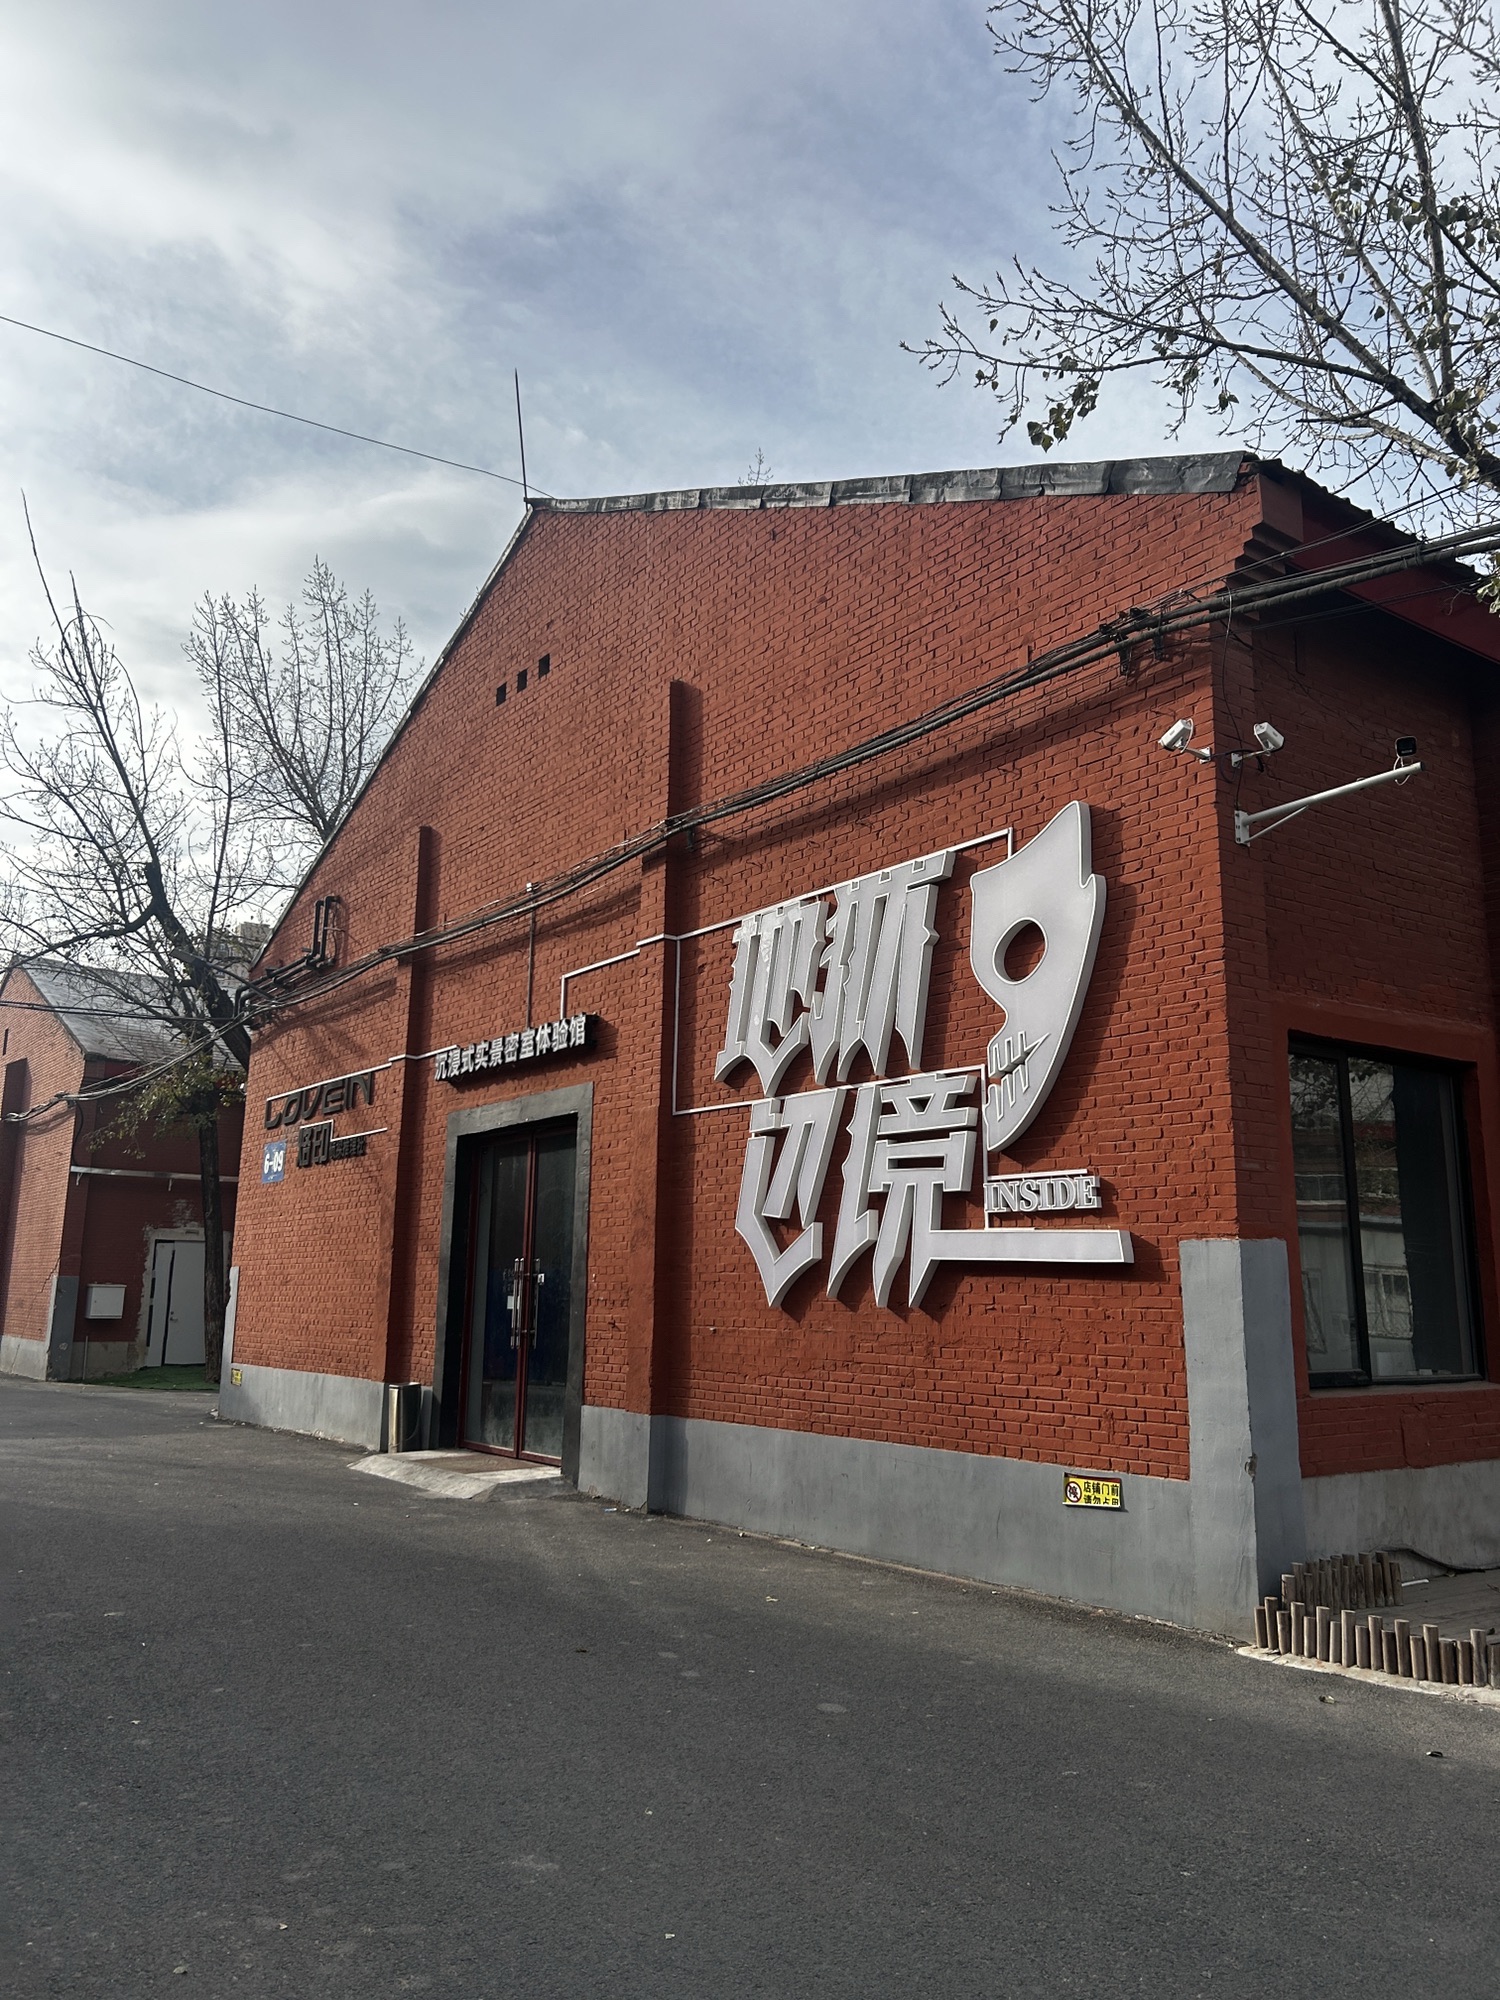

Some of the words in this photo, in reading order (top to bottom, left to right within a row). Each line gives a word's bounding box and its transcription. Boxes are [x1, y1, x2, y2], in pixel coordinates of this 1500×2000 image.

[434, 1015, 586, 1080] 沉浸式实景密室体验馆
[264, 1150, 285, 1175] 6-09
[984, 1175, 1103, 1214] INSIDE
[1084, 1482, 1119, 1497] 店铺门前
